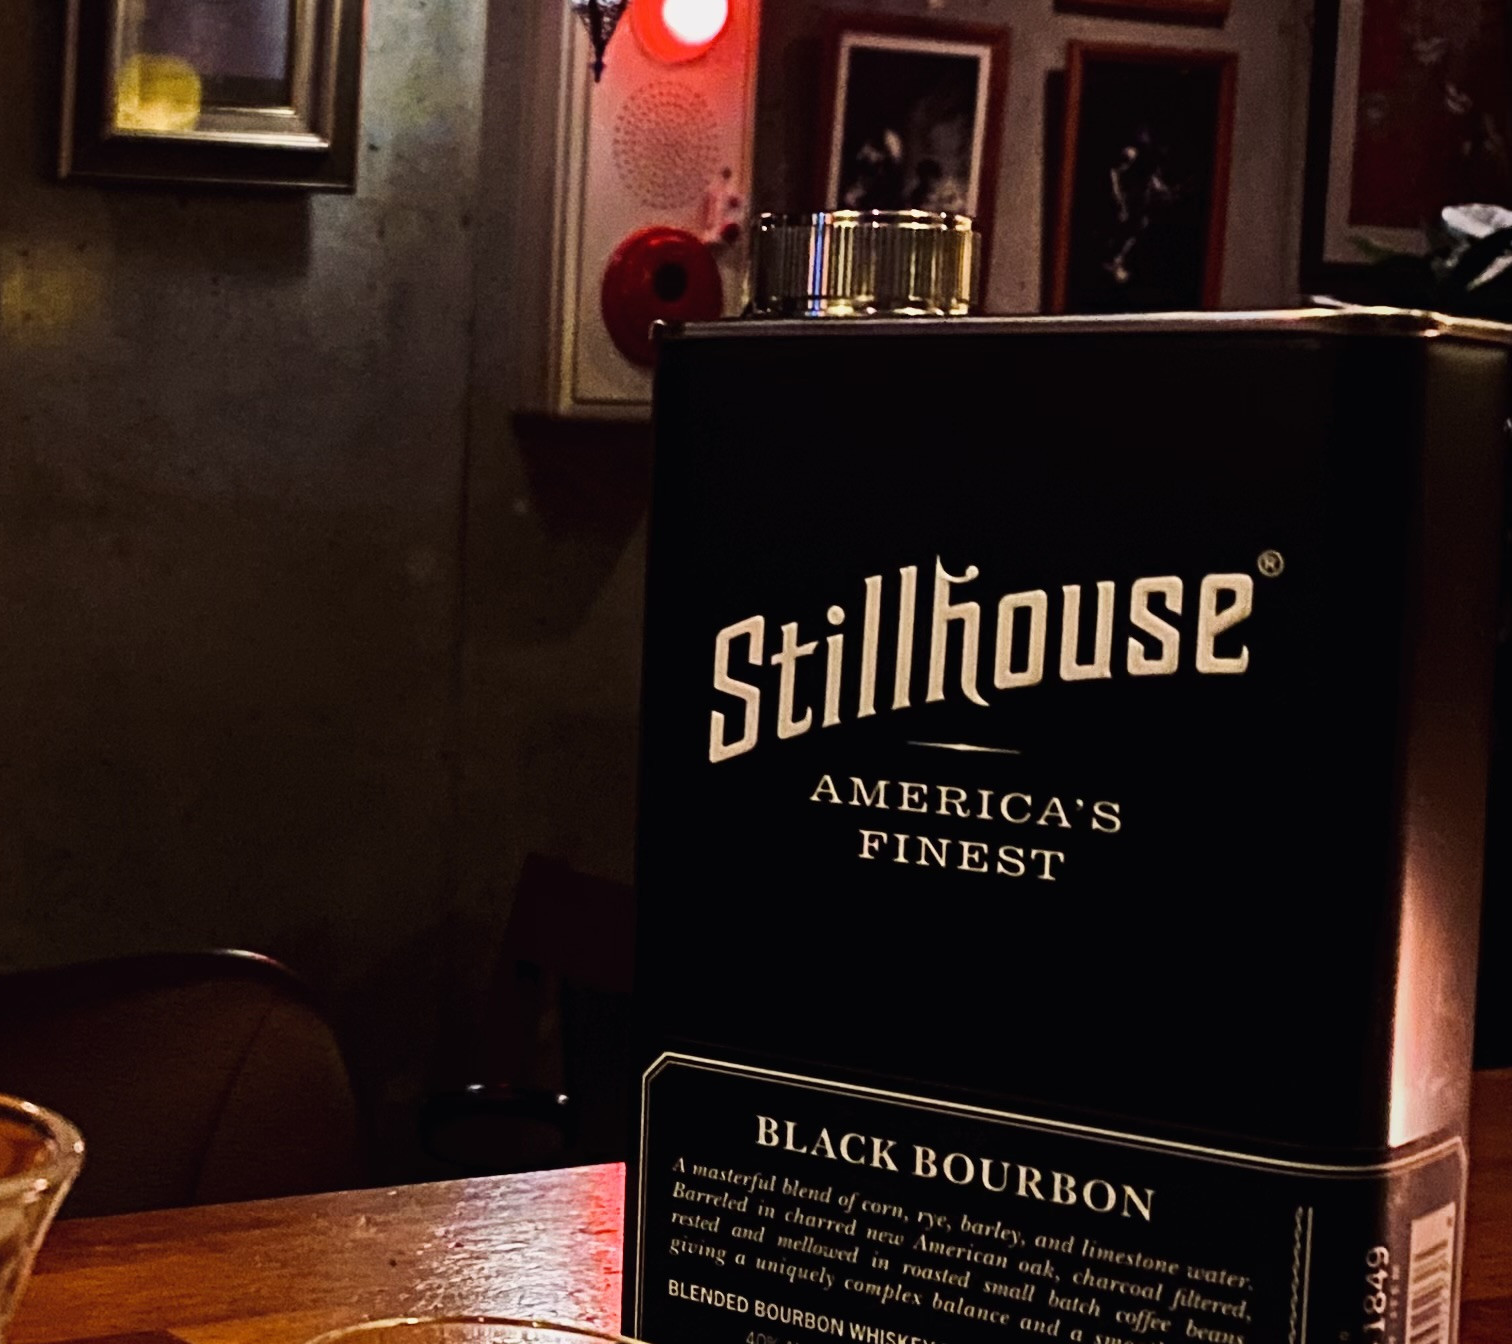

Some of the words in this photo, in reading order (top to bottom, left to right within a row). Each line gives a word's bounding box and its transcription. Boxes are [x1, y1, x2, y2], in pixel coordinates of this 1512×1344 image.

[809, 773, 1123, 833] AMERICA'S
[858, 828, 1065, 881] FINEST
[755, 1114, 899, 1174] BLACK
[912, 1143, 1156, 1223] BOURBON
[671, 1211, 721, 1234] rested
[731, 1225, 766, 1244] and
[777, 1235, 860, 1265] mellowed
[871, 1250, 890, 1271] in
[902, 1262, 971, 1289] roasted
[983, 1279, 1036, 1303] small
[1048, 1290, 1101, 1317] batch
[1115, 1308, 1172, 1334] coffee
[672, 1157, 686, 1174] A
[692, 1164, 777, 1194] masterful
[782, 1178, 833, 1204] blend
[838, 1192, 861, 1214] of
[861, 1198, 909, 1223] corn,
[917, 1210, 953, 1234] rye,
[960, 1214, 1026, 1249] barley,
[1034, 1233, 1075, 1254] and
[1082, 1238, 1180, 1276] limestone
[1186, 1265, 1254, 1292] water.
[672, 1181, 749, 1213] Barreled
[758, 1199, 776, 1219] in
[784, 1207, 858, 1236] charred
[867, 1226, 905, 1246] new
[913, 1233, 1008, 1269] American
[1018, 1259, 1061, 1284] oak,
[1072, 1268, 1164, 1302] charcoal
[1169, 1288, 1253, 1324] filtered,
[668, 1279, 749, 1314] BLENDED
[754, 1300, 845, 1338] BOURBON
[669, 1235, 727, 1267] giving
[735, 1251, 746, 1266] a
[756, 1256, 835, 1291] uniquely
[844, 1277, 923, 1306] complex
[932, 1292, 1010, 1326] balance
[1020, 1316, 1061, 1338] and
[1070, 1328, 1084, 1343] a
